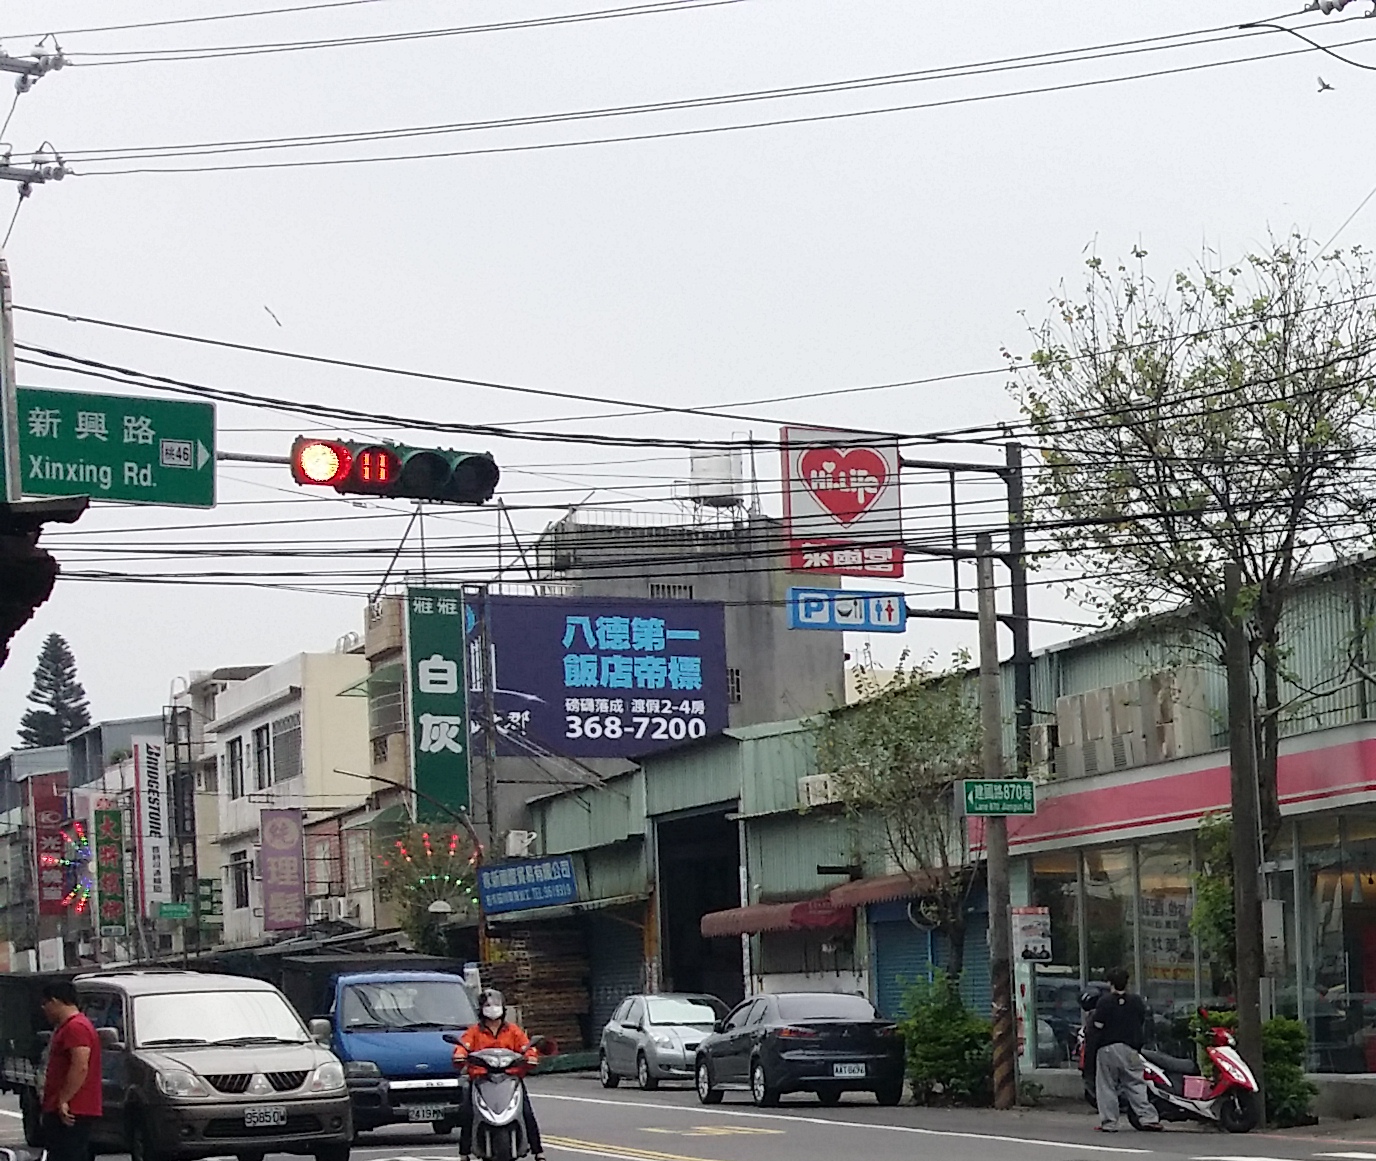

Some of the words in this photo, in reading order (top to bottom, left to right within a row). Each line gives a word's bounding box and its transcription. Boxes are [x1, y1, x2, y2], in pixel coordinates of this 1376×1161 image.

[28, 406, 156, 445] 新興路
[29, 454, 112, 490] Xinxing
[124, 462, 157, 487] Rd.
[362, 452, 386, 480] 11
[562, 616, 700, 651] 八德第一
[563, 654, 702, 690] 飯店帝標
[418, 654, 463, 753] 白灰
[565, 715, 706, 740] 368-7200
